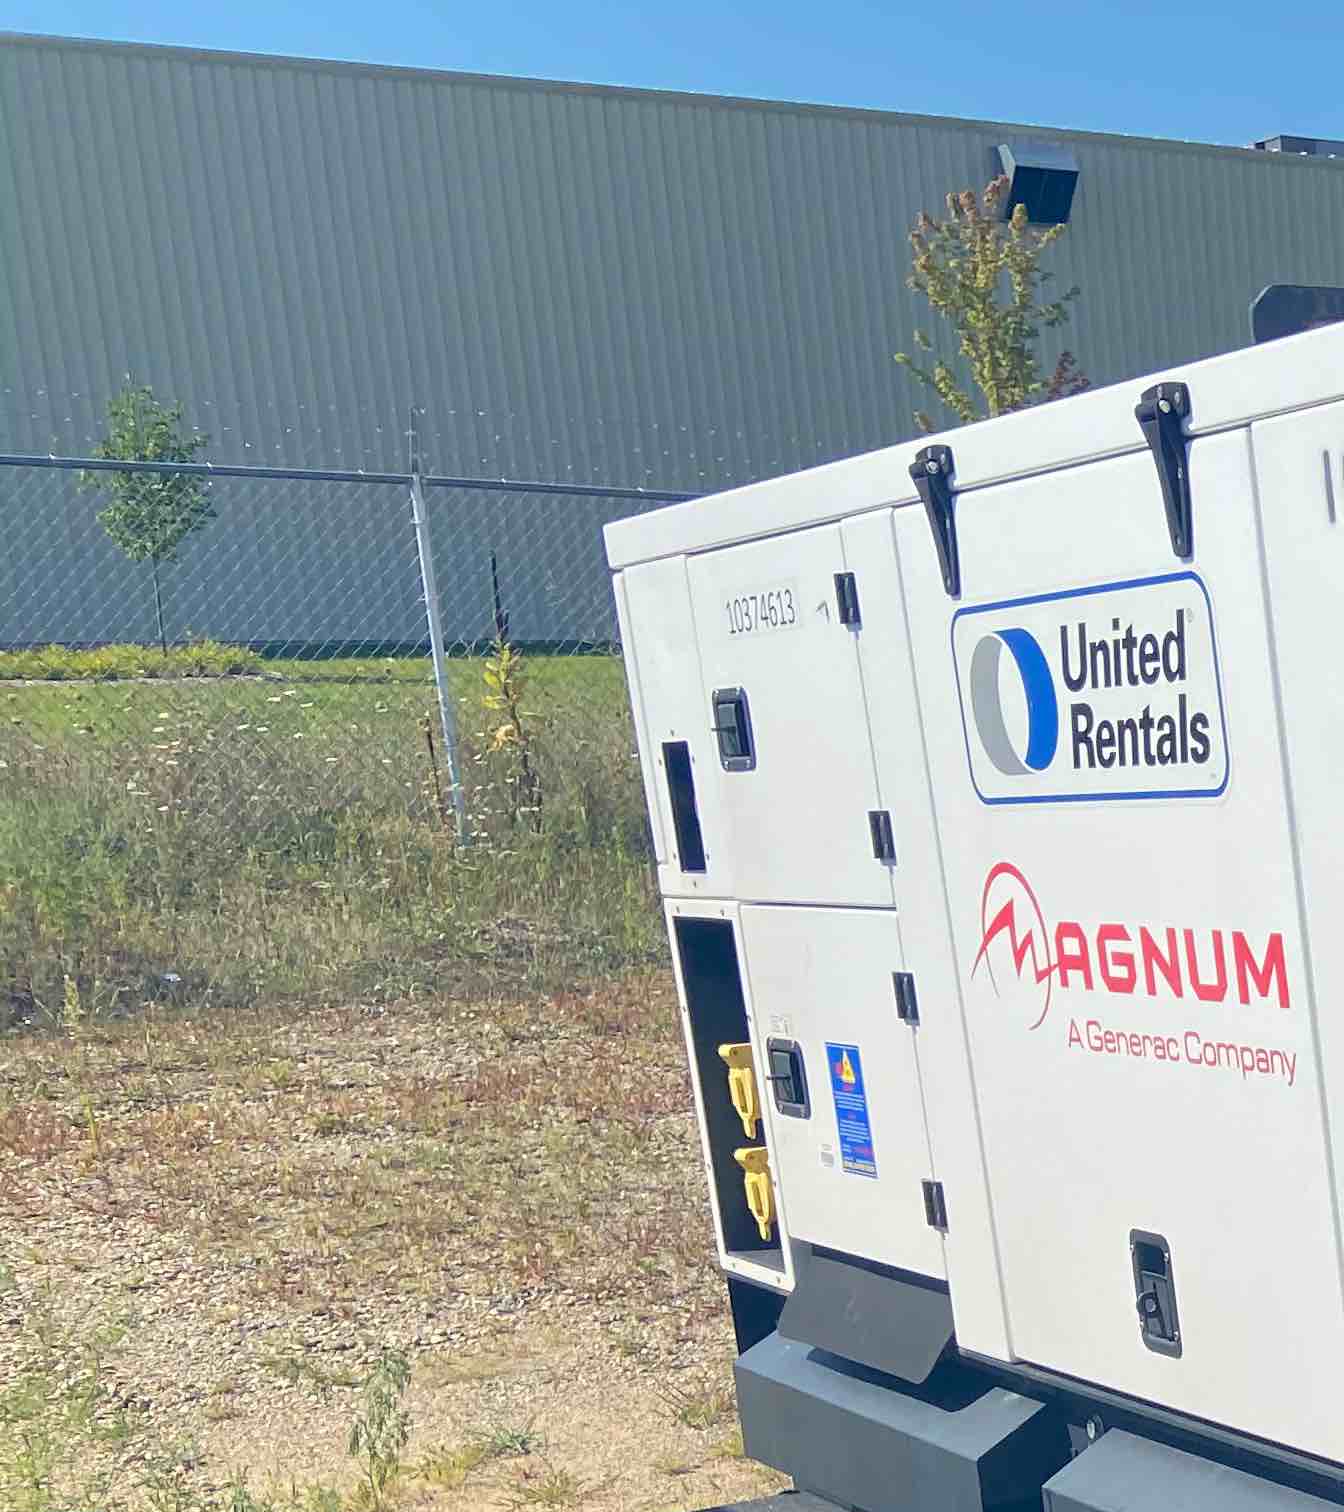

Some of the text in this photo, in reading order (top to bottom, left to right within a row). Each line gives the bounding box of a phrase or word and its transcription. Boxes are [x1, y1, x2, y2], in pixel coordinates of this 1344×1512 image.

[725, 588, 796, 634] 10374613
[1060, 608, 1188, 692] United
[1070, 694, 1211, 771] Rentals
[1068, 1018, 1297, 1087] A Generac Company
